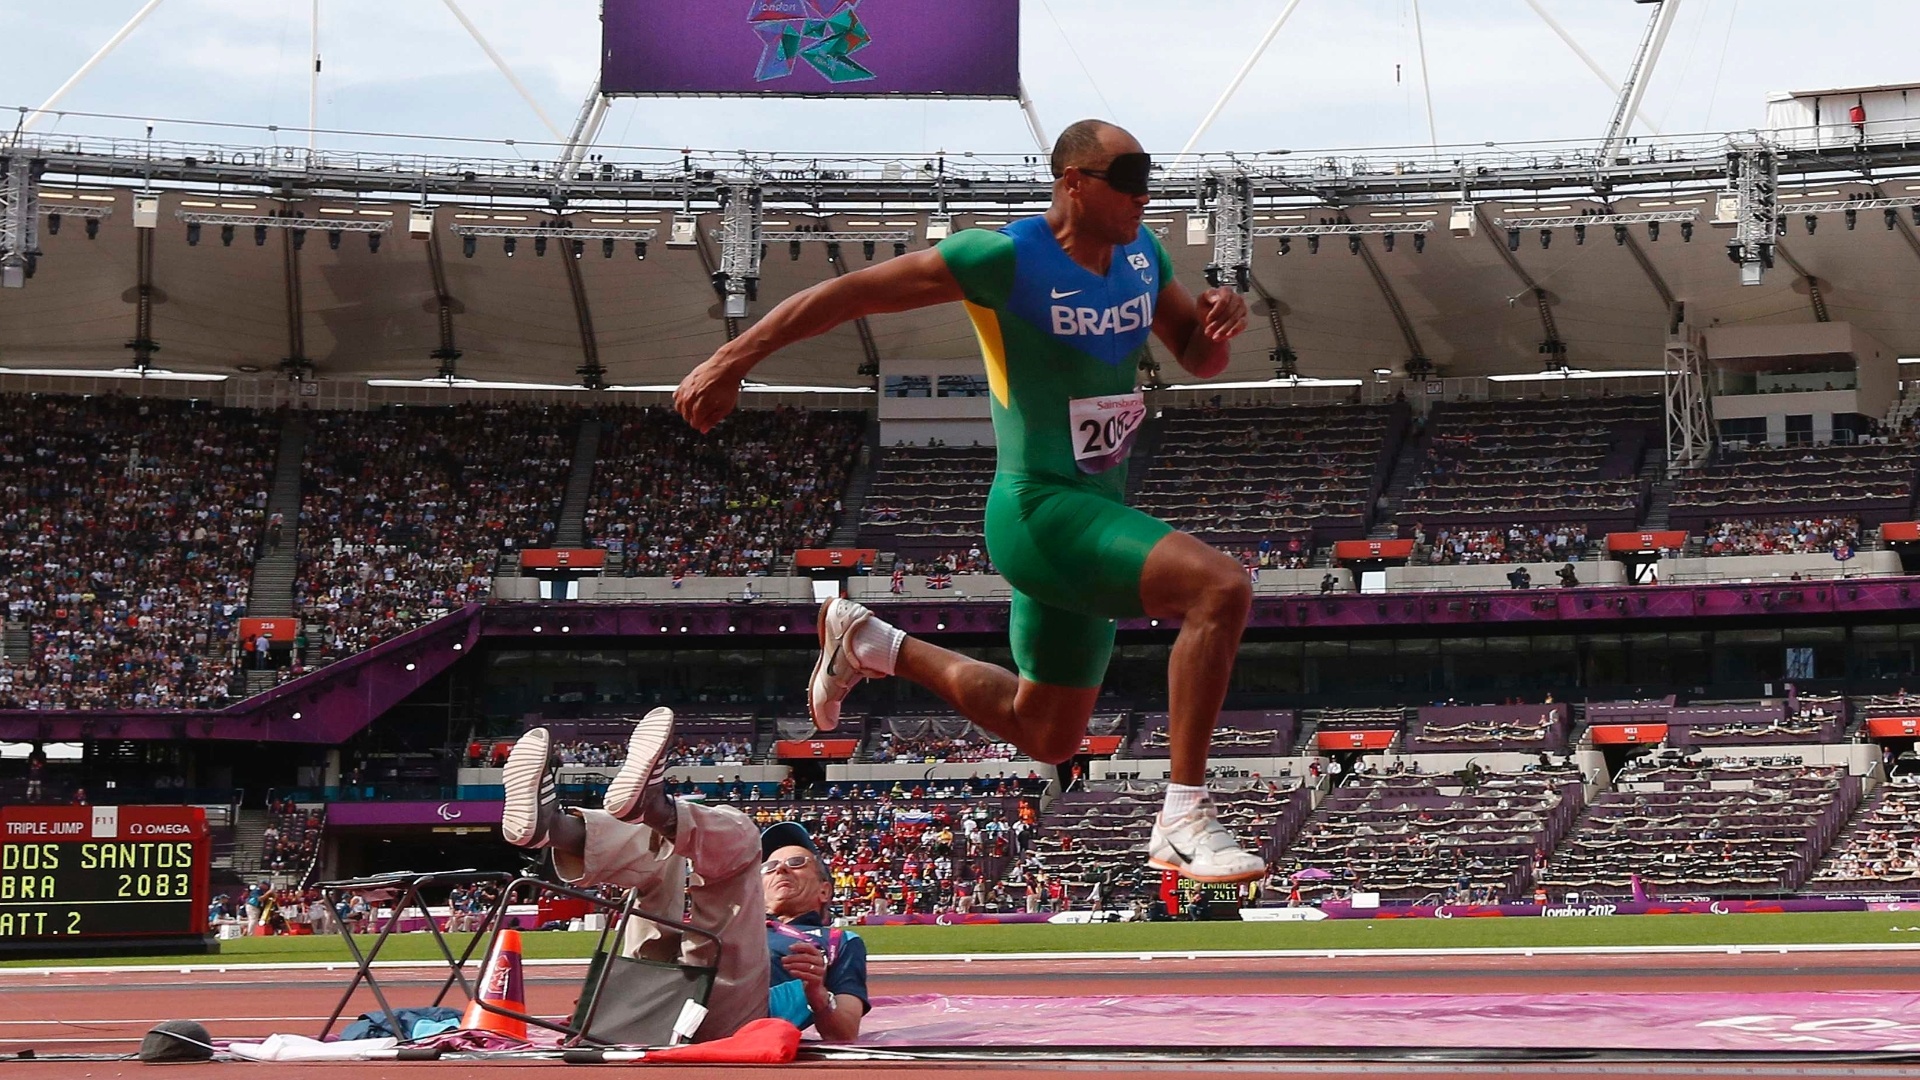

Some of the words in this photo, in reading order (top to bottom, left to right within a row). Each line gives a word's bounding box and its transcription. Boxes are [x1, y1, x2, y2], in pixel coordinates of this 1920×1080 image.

[1051, 292, 1153, 335] BRASIL
[95, 816, 114, 825] F11
[6, 822, 47, 834] TRIPLE
[49, 822, 84, 834] JUMP
[145, 824, 191, 834] OMEGA
[2, 844, 60, 870] DOS
[80, 843, 192, 869] SANTOS
[1, 875, 55, 898] BRA
[118, 874, 188, 897] 2083
[1213, 890, 1237, 900] 2411
[1541, 905, 1586, 917] London
[1588, 905, 1617, 917] 2012
